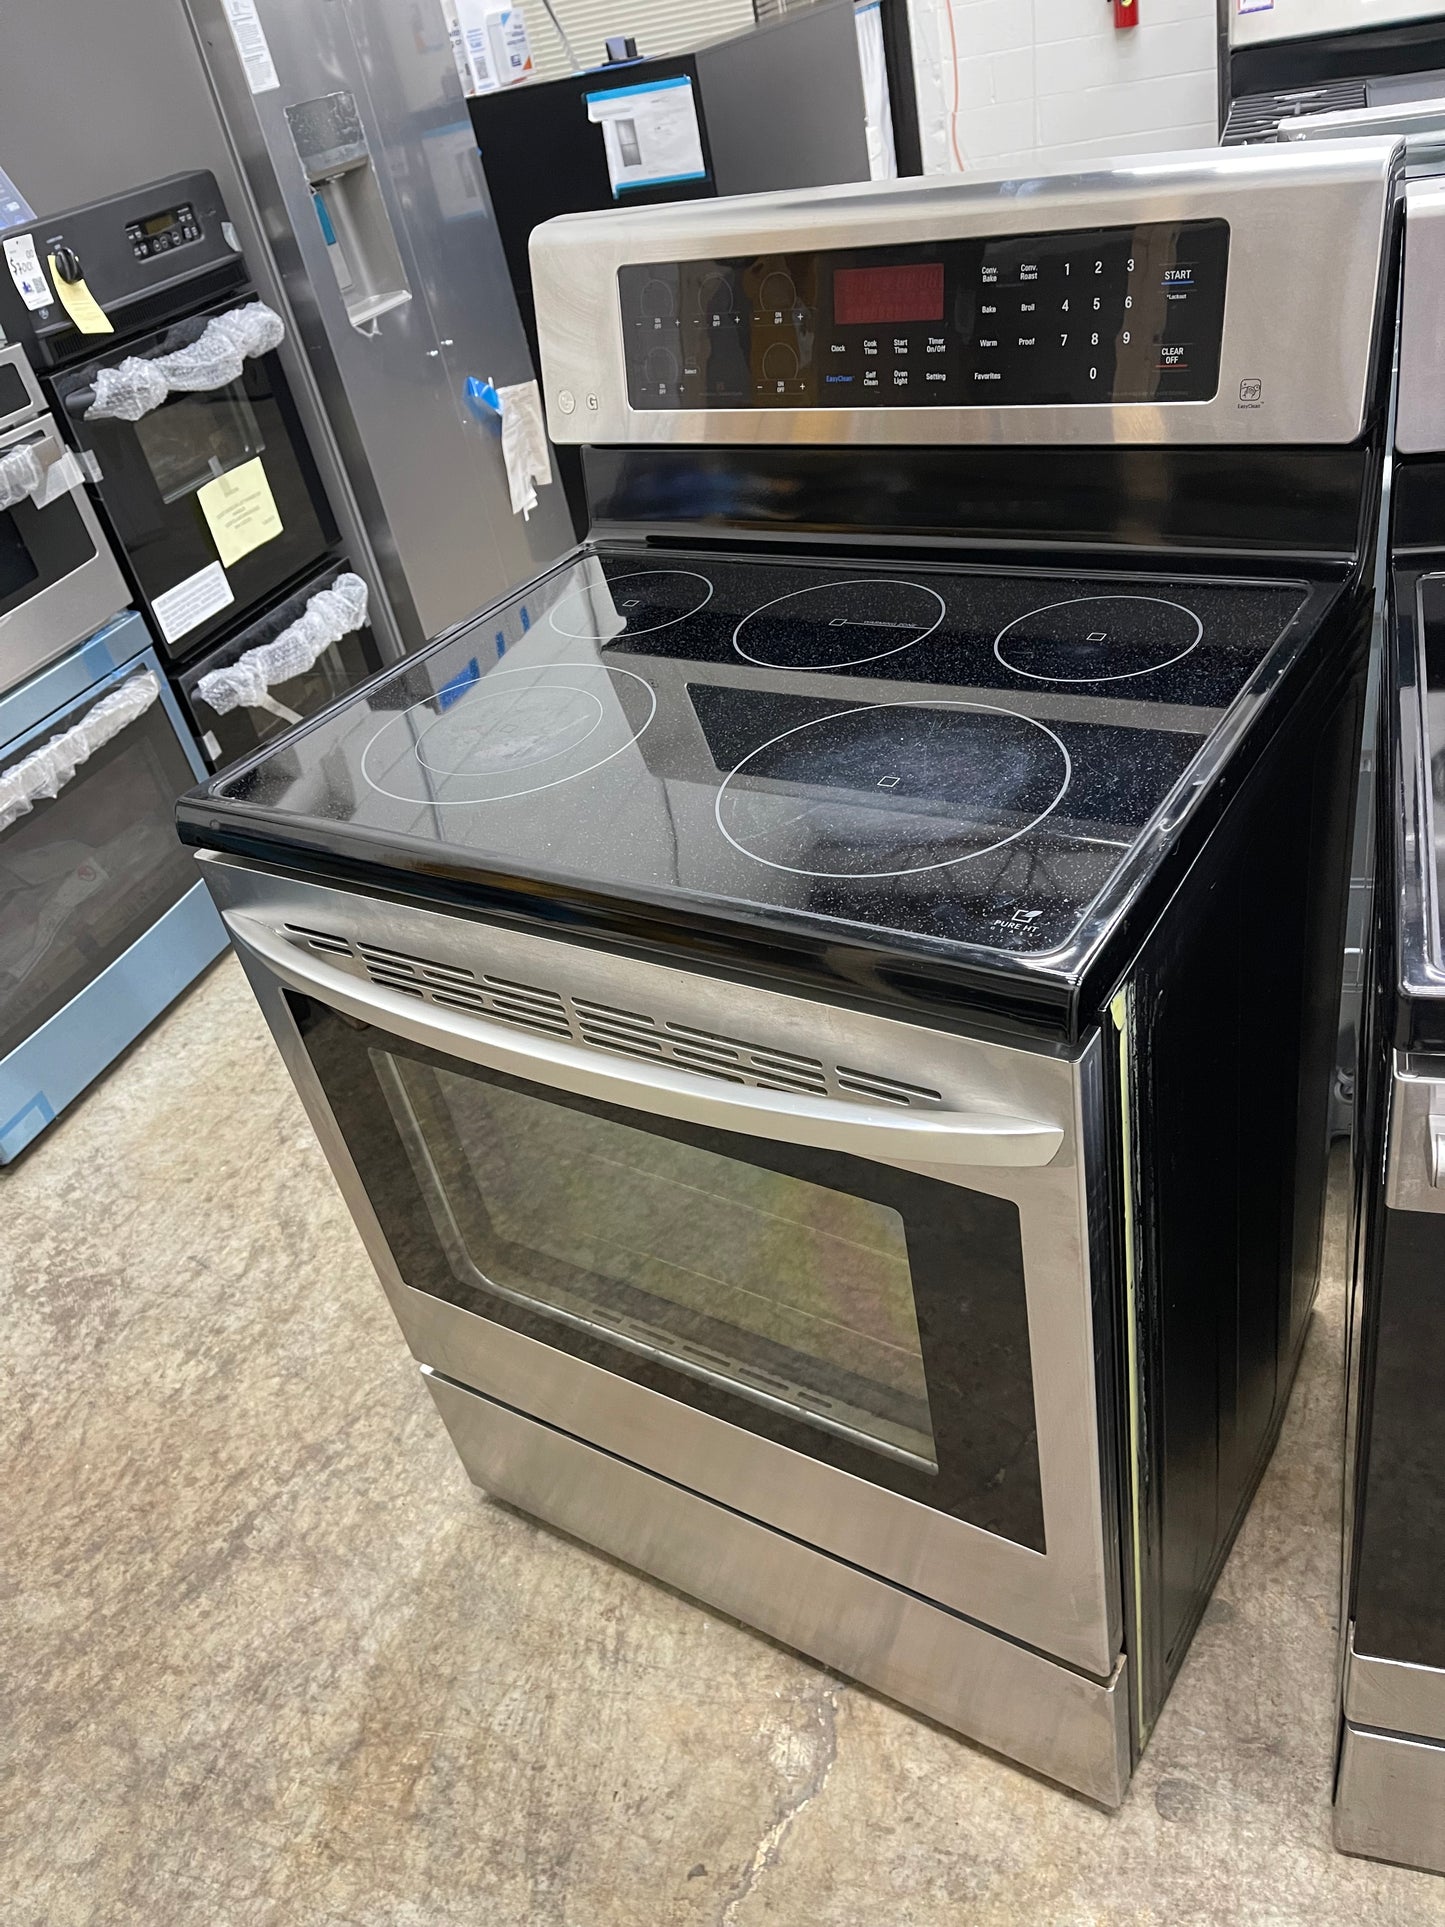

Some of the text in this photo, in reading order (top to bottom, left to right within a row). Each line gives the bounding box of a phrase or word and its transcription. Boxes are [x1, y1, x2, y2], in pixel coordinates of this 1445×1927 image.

[981, 266, 999, 275] Conv.
[1020, 263, 1039, 272] Conv.
[1064, 258, 1135, 276] 1 2 3
[982, 274, 998, 283] Bake
[1019, 271, 1038, 280] Roast
[1164, 269, 1192, 281] START
[1020, 303, 1036, 312] Broil
[1061, 295, 1133, 312] 4 5 6
[981, 305, 997, 314] Bake
[774, 317, 783, 325] OFF
[863, 339, 878, 348] Cook
[893, 338, 908, 347] Start
[927, 337, 945, 345] Timer
[979, 339, 998, 347] Warm
[1018, 337, 1036, 346] Proof
[1060, 331, 1131, 347] 7 8 9
[830, 344, 846, 353] Clock
[864, 347, 878, 355] Time
[894, 346, 908, 355] Time
[926, 345, 946, 353] On/Off
[1161, 347, 1184, 356] CLEAR
[1165, 356, 1179, 364] OFF
[865, 370, 877, 379] Self
[893, 369, 909, 378] Oven
[925, 372, 947, 382] Setting
[974, 372, 1001, 380] Favorites
[1089, 367, 1098, 380] 0
[863, 378, 879, 386] Clean
[893, 377, 908, 386] Light
[994, 920, 1021, 930] PURE
